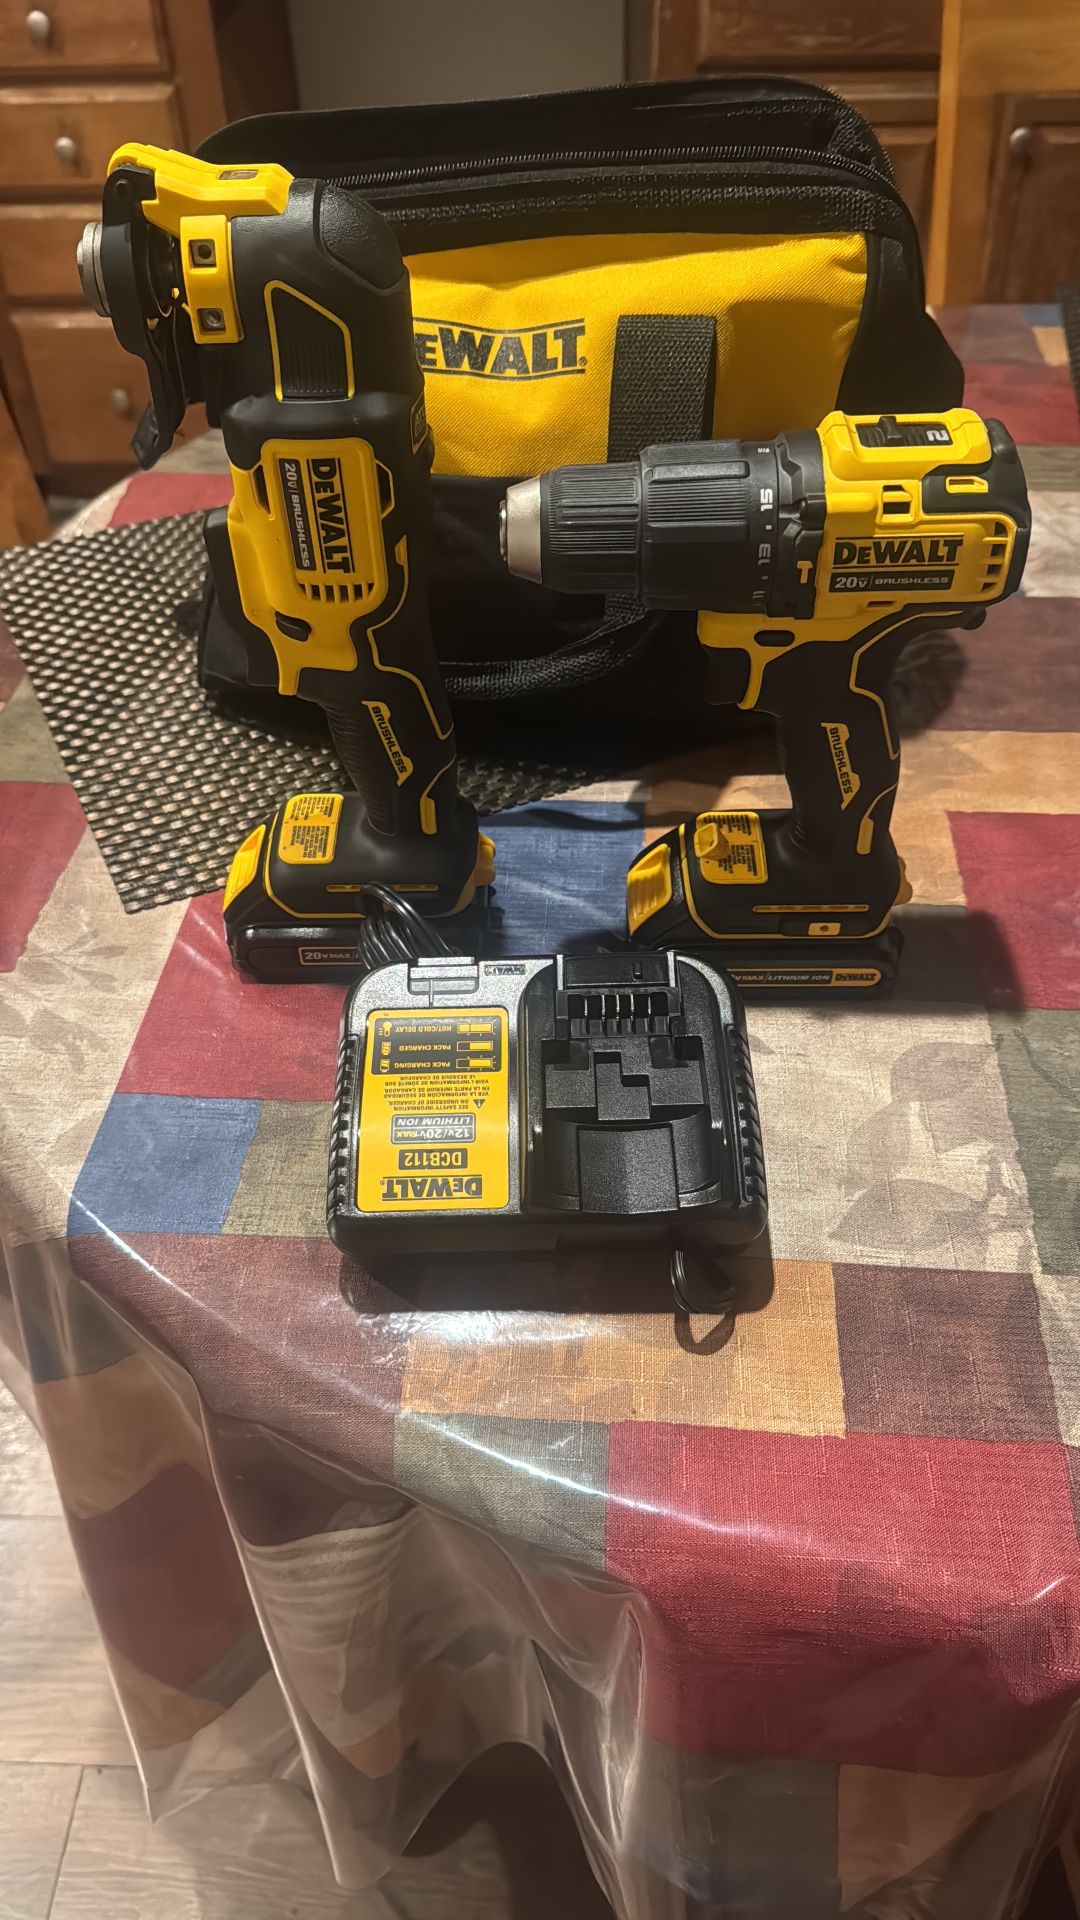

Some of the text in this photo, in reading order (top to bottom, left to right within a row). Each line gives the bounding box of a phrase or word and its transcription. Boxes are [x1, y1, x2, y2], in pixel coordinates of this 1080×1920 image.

[415, 325, 586, 376] EWALT
[926, 430, 950, 441] 2
[760, 488, 773, 512] 15
[311, 458, 351, 573] DEWALT
[291, 494, 310, 567] BRUSHLESS
[758, 543, 771, 566] 13
[832, 539, 963, 566] DEWALT
[875, 576, 949, 586] BRUSHLESS
[372, 706, 408, 774] BRUSHLESS
[829, 727, 853, 794] BRUSHLESS
[397, 1116, 470, 1126] LITHIUM ION
[404, 1151, 462, 1167] DCB112
[382, 1177, 482, 1199] DEWALT
